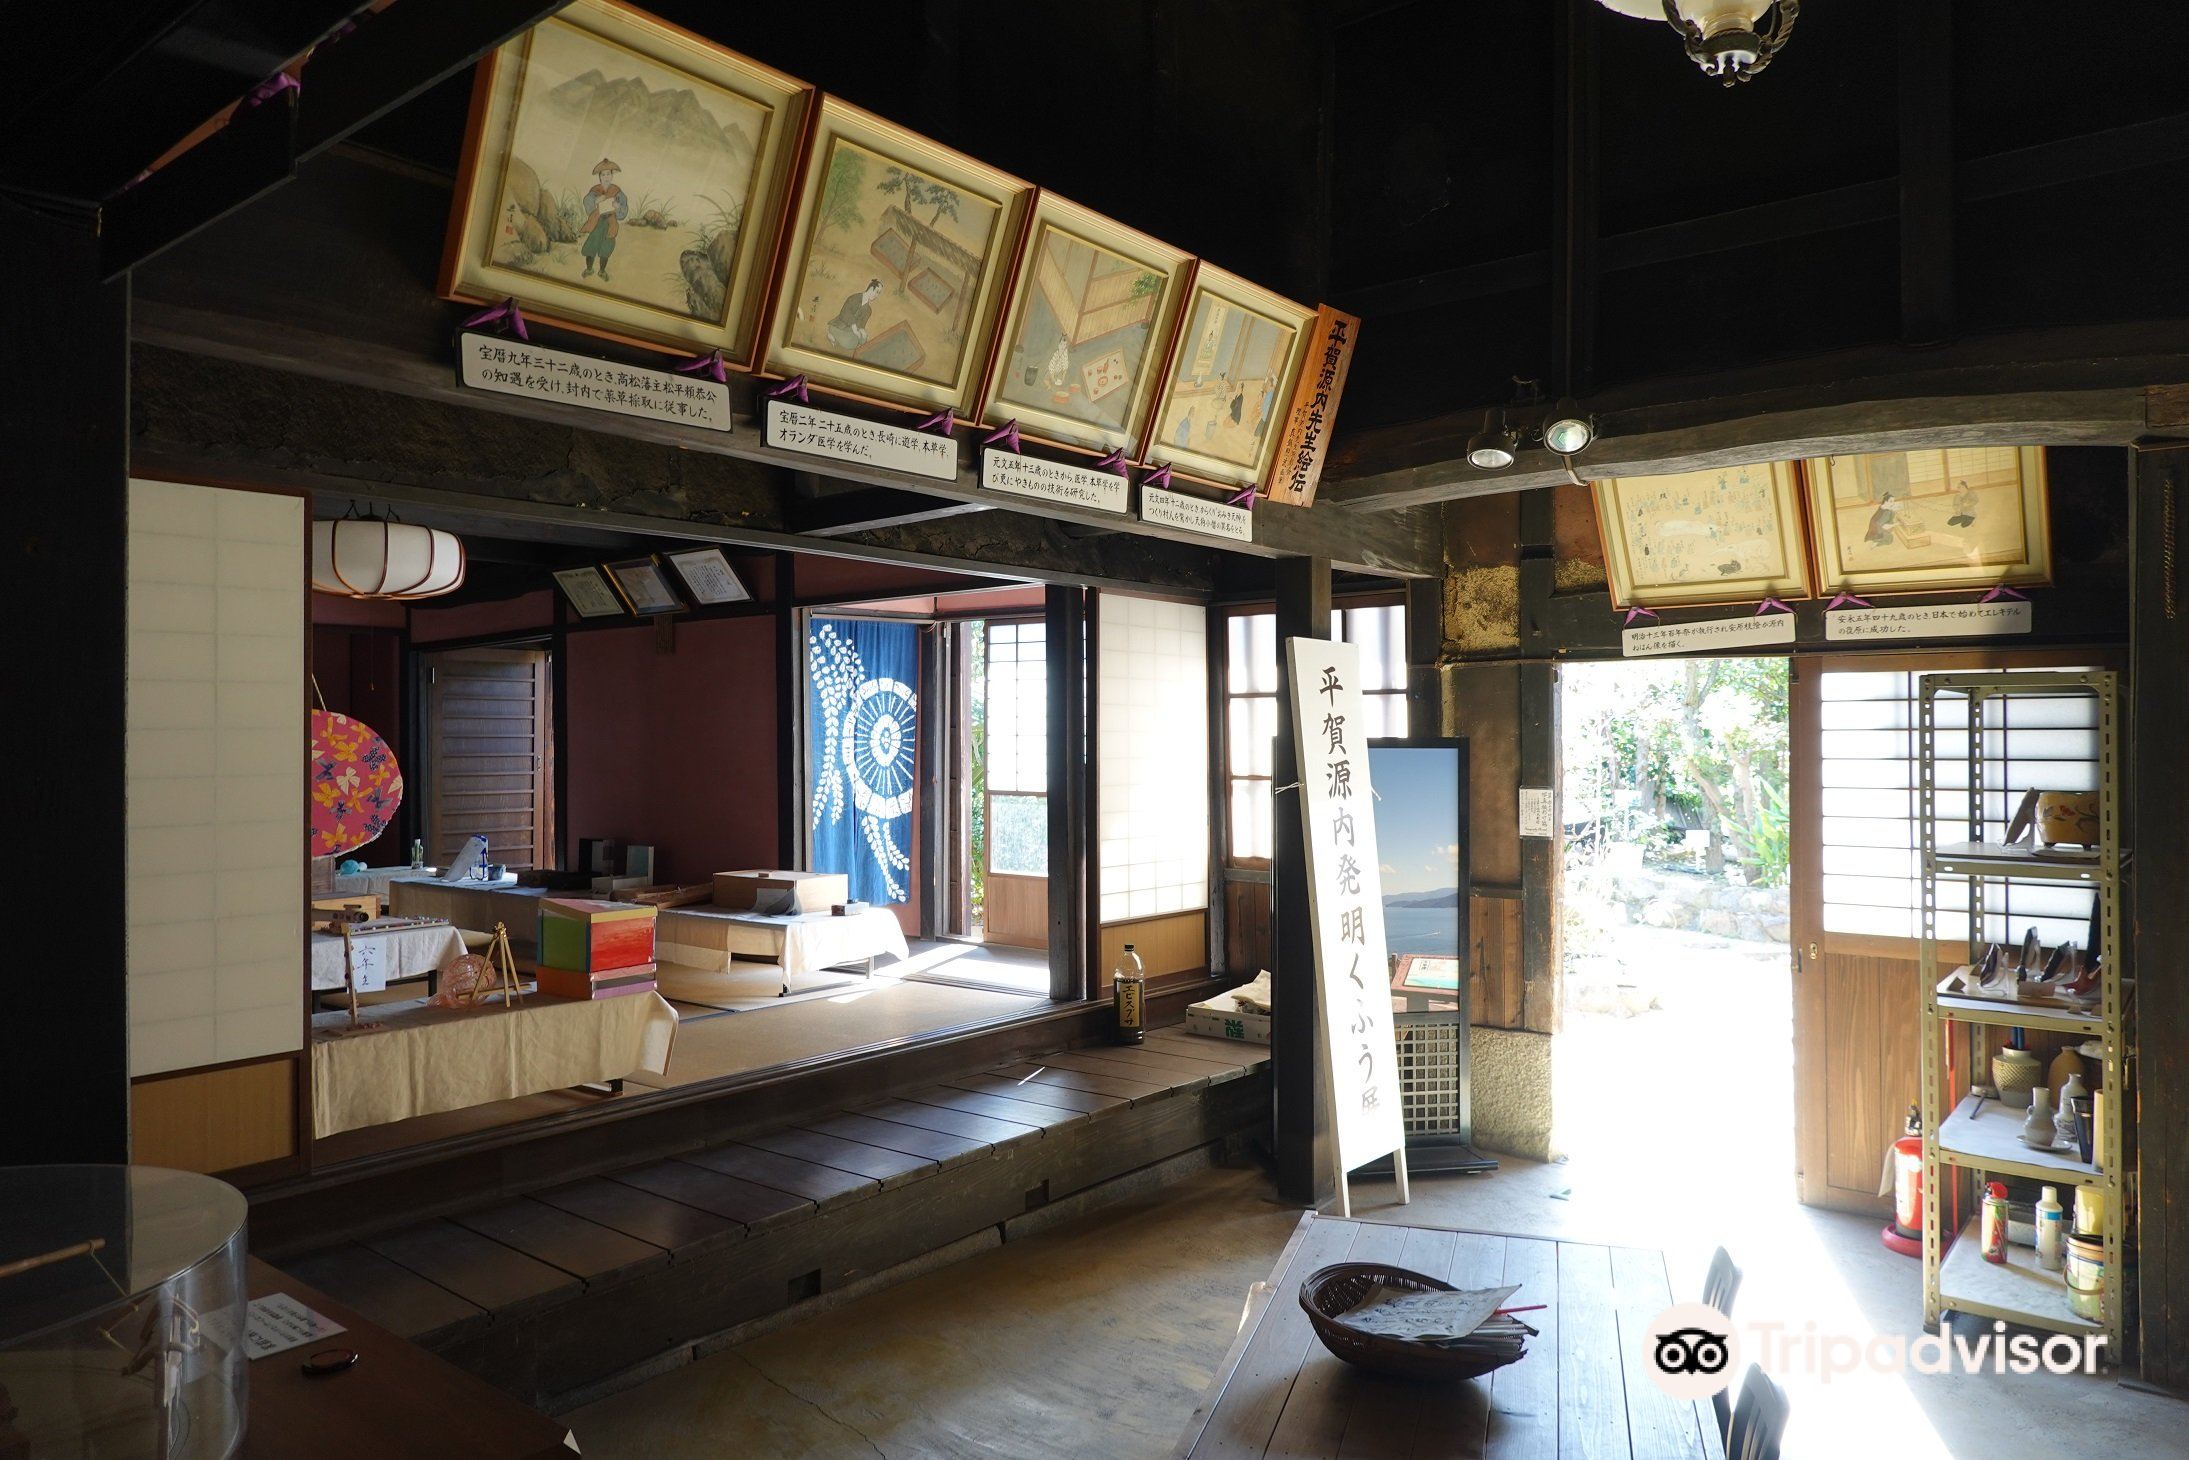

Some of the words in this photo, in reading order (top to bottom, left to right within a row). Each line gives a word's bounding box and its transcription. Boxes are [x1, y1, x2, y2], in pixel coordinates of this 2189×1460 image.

[1288, 320, 1348, 493] 平賀源内先生絵伝
[1318, 666, 1380, 1113] 平賀源内発明くふう展
[357, 944, 377, 986] 六年生
[1122, 984, 1136, 1026] エビスグサ
